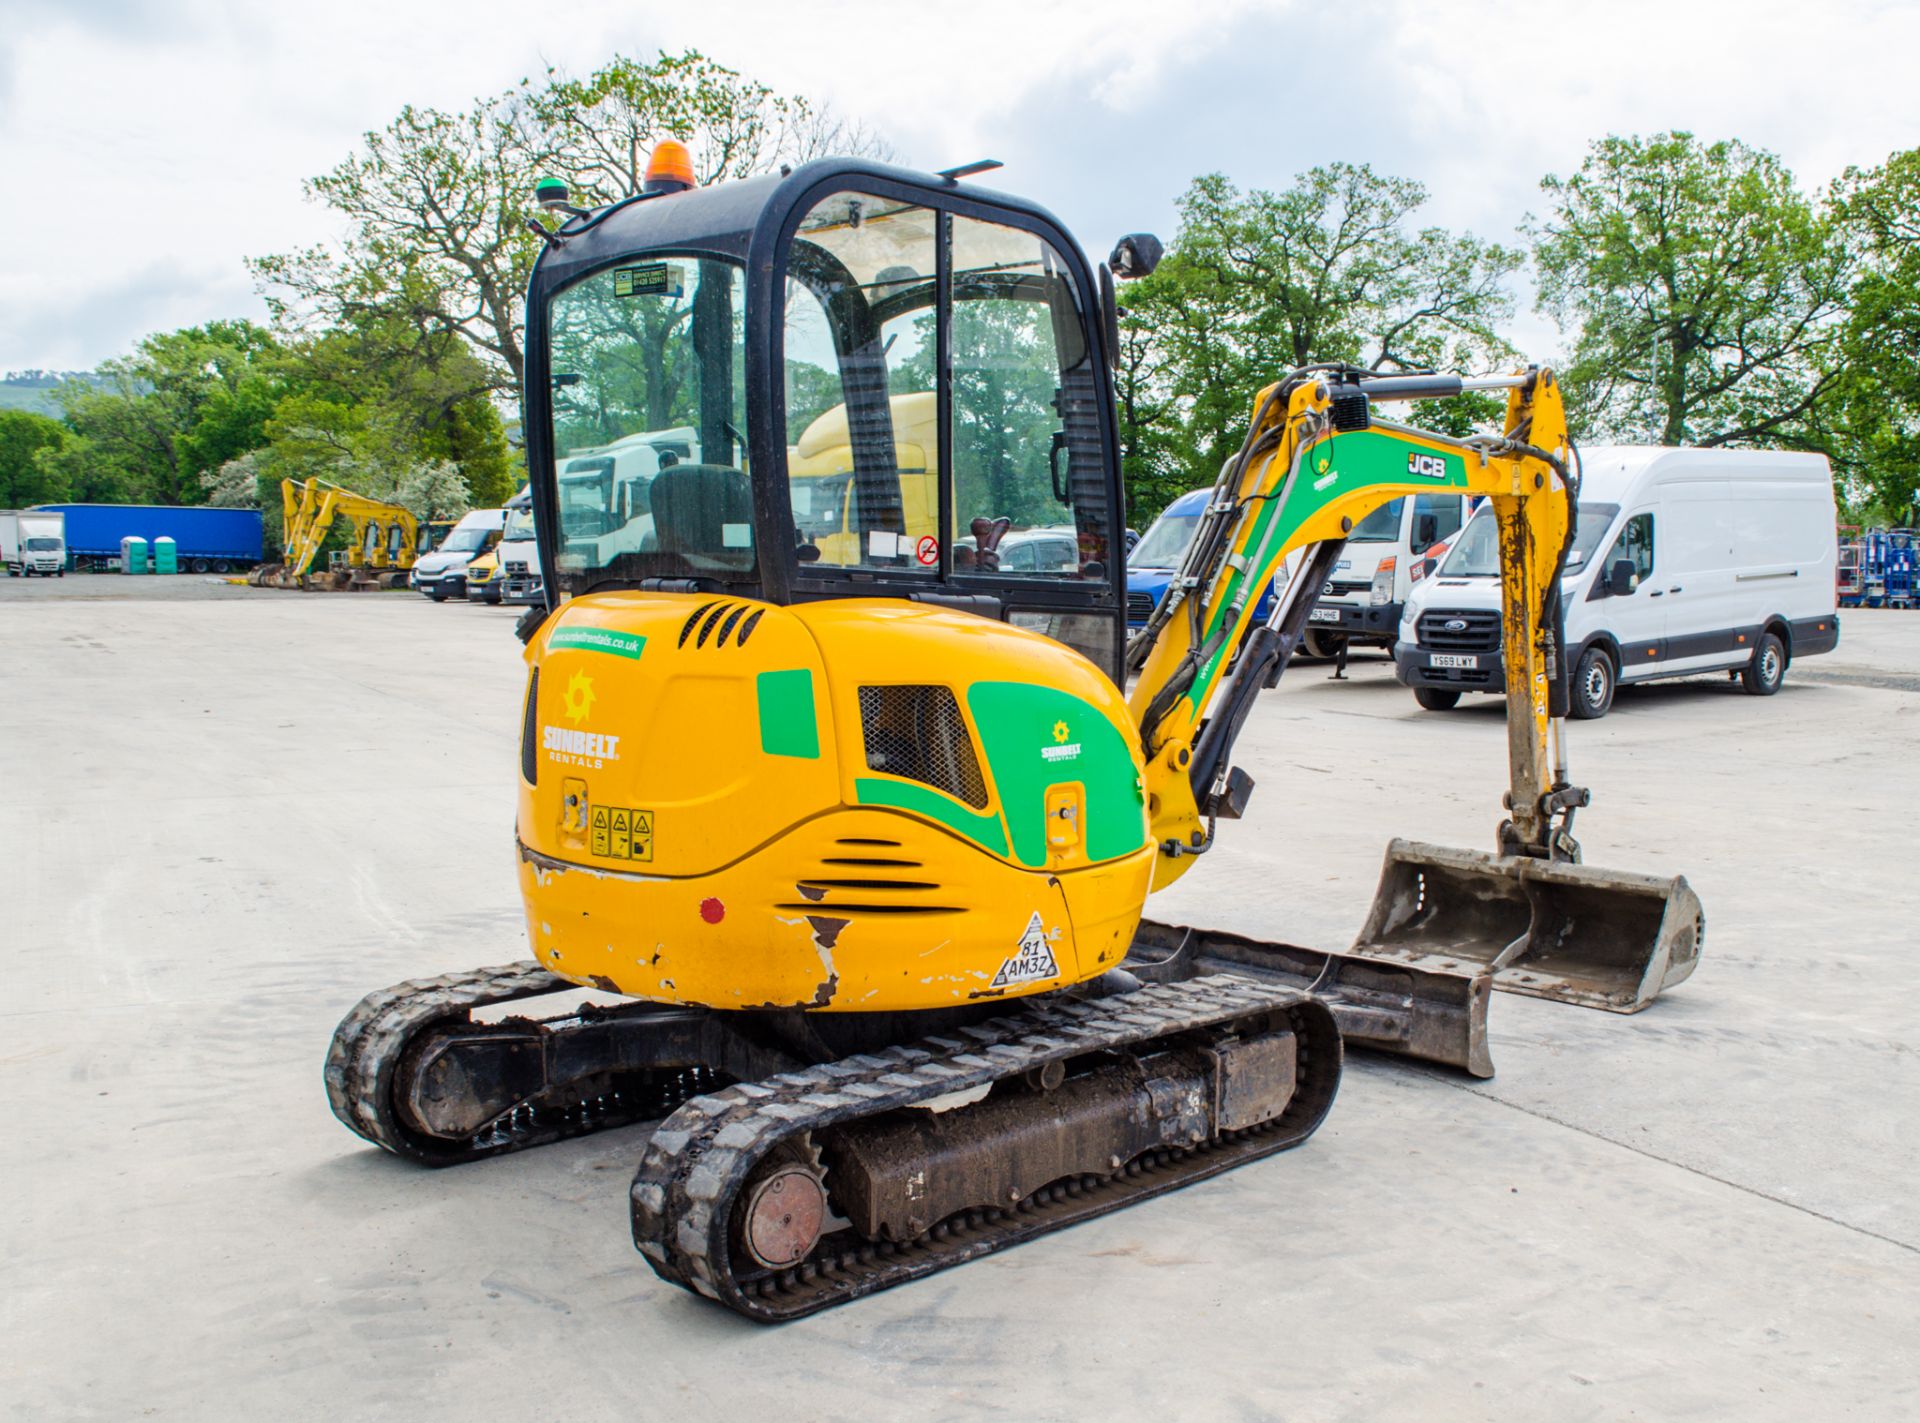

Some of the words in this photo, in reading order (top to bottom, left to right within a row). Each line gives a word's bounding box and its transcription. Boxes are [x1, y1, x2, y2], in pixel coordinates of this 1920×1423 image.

[1408, 453, 1446, 478] JCB
[1433, 655, 1455, 666] YS69
[543, 725, 620, 760] SUNBELT
[1041, 743, 1082, 759] SUNBELT
[549, 752, 603, 769] RENTALS
[1022, 941, 1039, 956] 81
